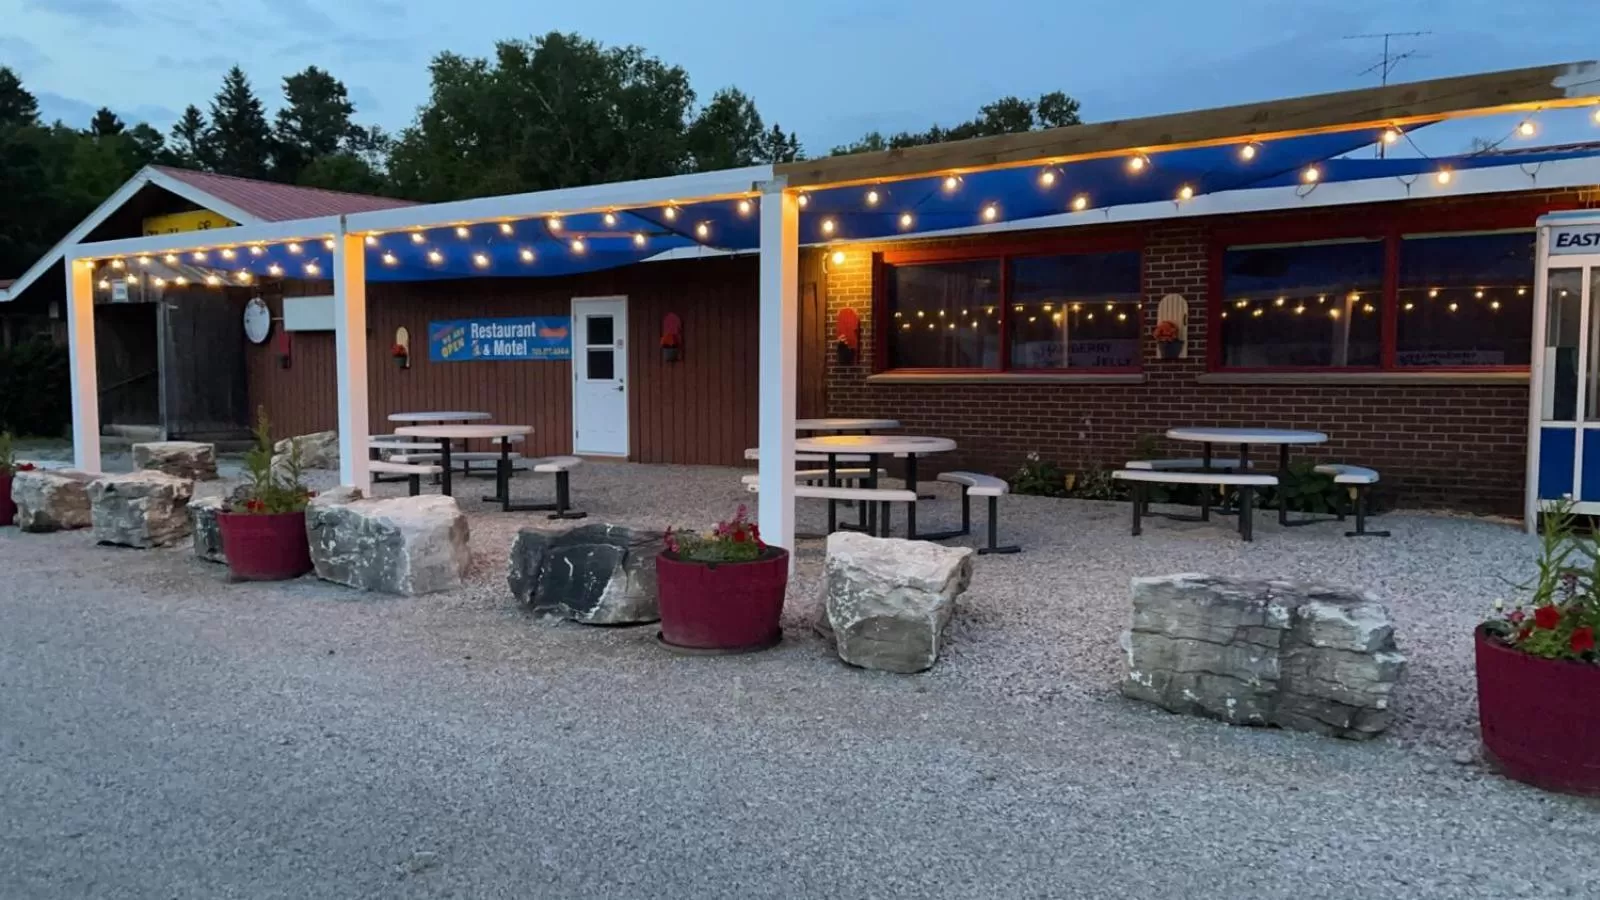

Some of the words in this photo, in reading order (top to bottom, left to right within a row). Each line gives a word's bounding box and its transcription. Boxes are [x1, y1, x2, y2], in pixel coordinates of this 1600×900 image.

[471, 321, 536, 339] Restaurant
[441, 337, 464, 358] OPEN
[483, 343, 491, 356] &
[493, 339, 528, 356] Motel
